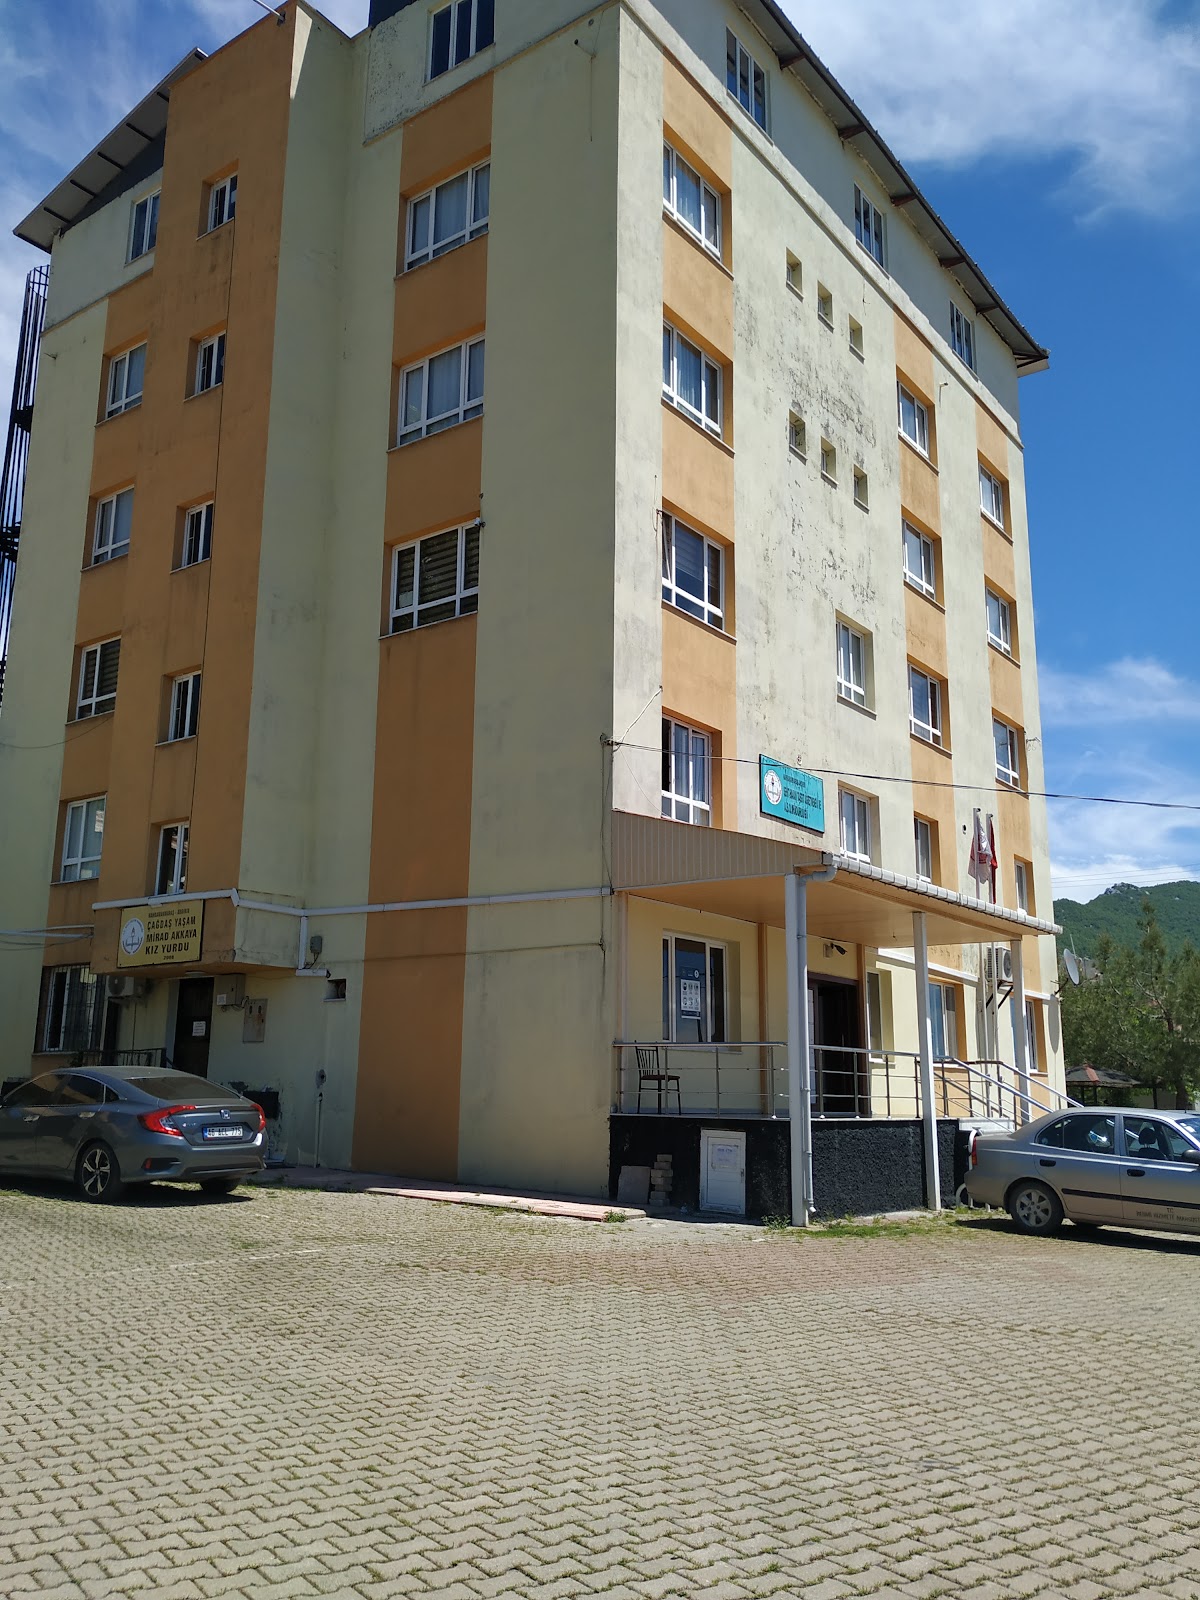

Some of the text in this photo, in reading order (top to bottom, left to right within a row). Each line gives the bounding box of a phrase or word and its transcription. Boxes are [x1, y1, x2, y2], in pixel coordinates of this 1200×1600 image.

[147, 915, 196, 932] ÇAĞDAŞ YAŞAM
[146, 928, 197, 943] MİRAD AKKAYA
[145, 941, 189, 955] KIZ YURDU
